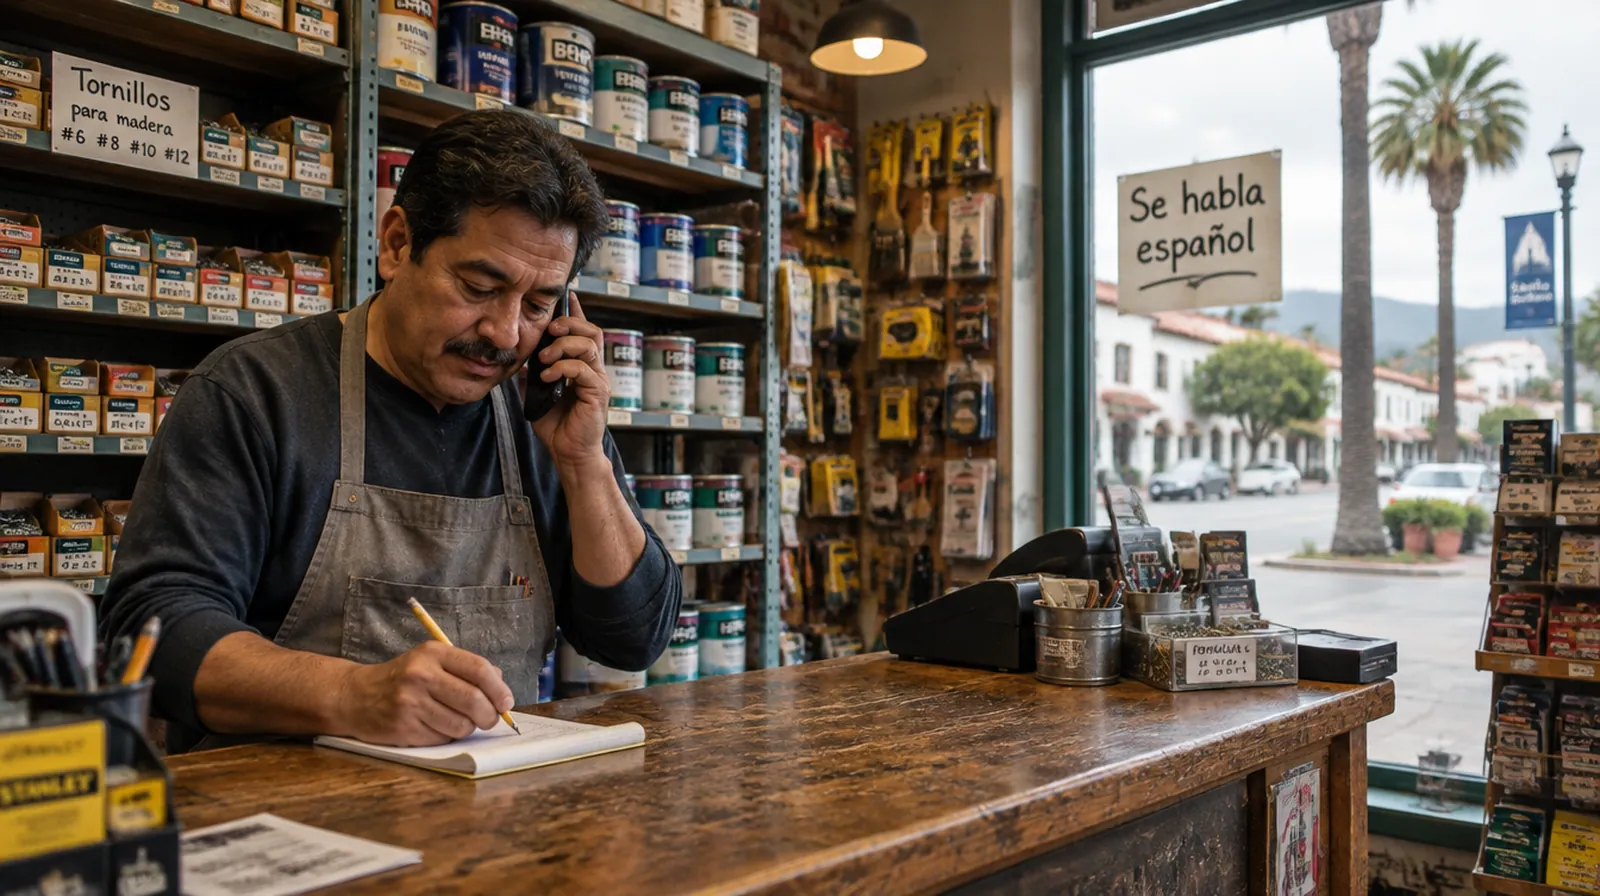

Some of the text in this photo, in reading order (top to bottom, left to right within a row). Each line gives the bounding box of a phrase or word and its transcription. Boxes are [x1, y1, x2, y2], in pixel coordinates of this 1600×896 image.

[70, 66, 171, 112] Tornillos
[71, 104, 174, 137] para madera
[61, 127, 86, 144] #6
[97, 133, 120, 151] #8
[129, 140, 157, 158] #10
[164, 147, 190, 165] #12
[1129, 172, 1265, 222] Se habla
[1136, 216, 1255, 273] español
